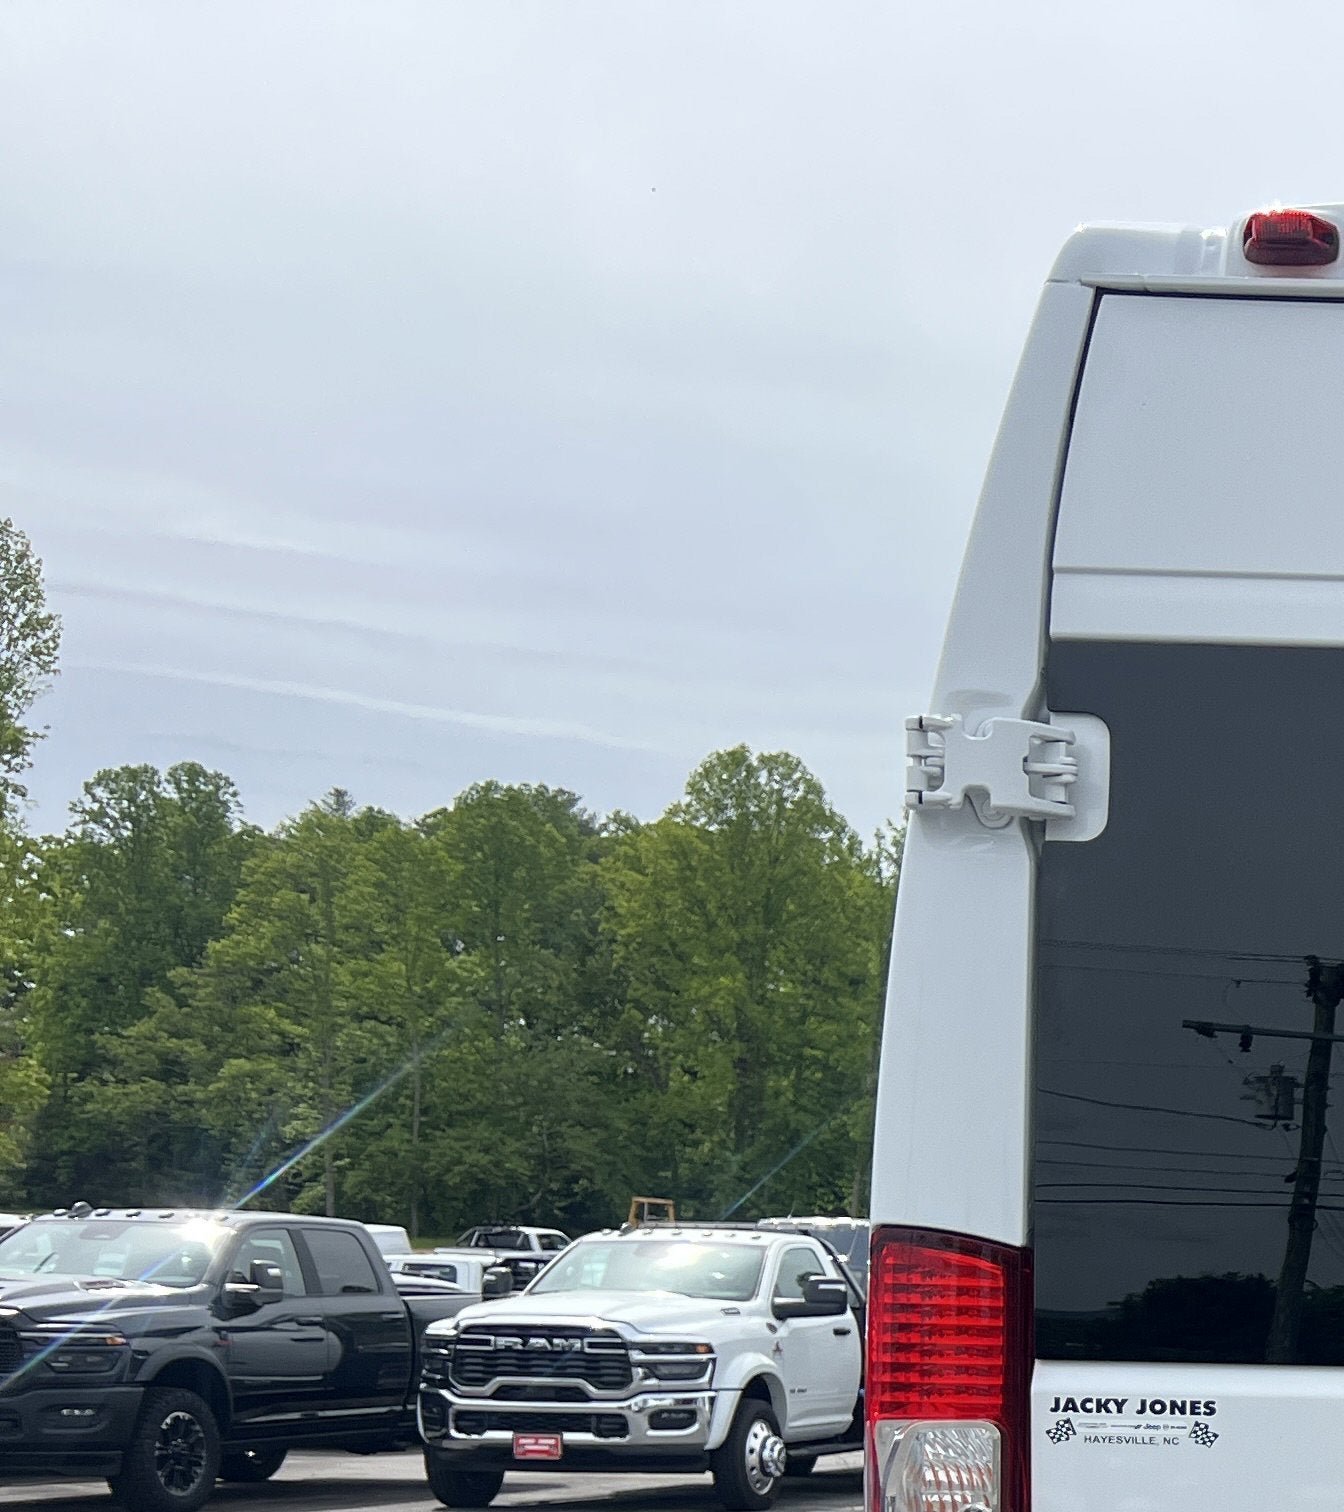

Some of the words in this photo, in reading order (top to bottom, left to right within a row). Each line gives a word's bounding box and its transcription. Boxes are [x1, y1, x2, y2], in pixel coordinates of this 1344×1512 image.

[495, 1337, 581, 1351] RAM
[1050, 1397, 1128, 1414] JACKY
[1136, 1399, 1217, 1416] JONES
[1084, 1435, 1160, 1446] HAYESVILLE,
[1163, 1437, 1180, 1445] NC
